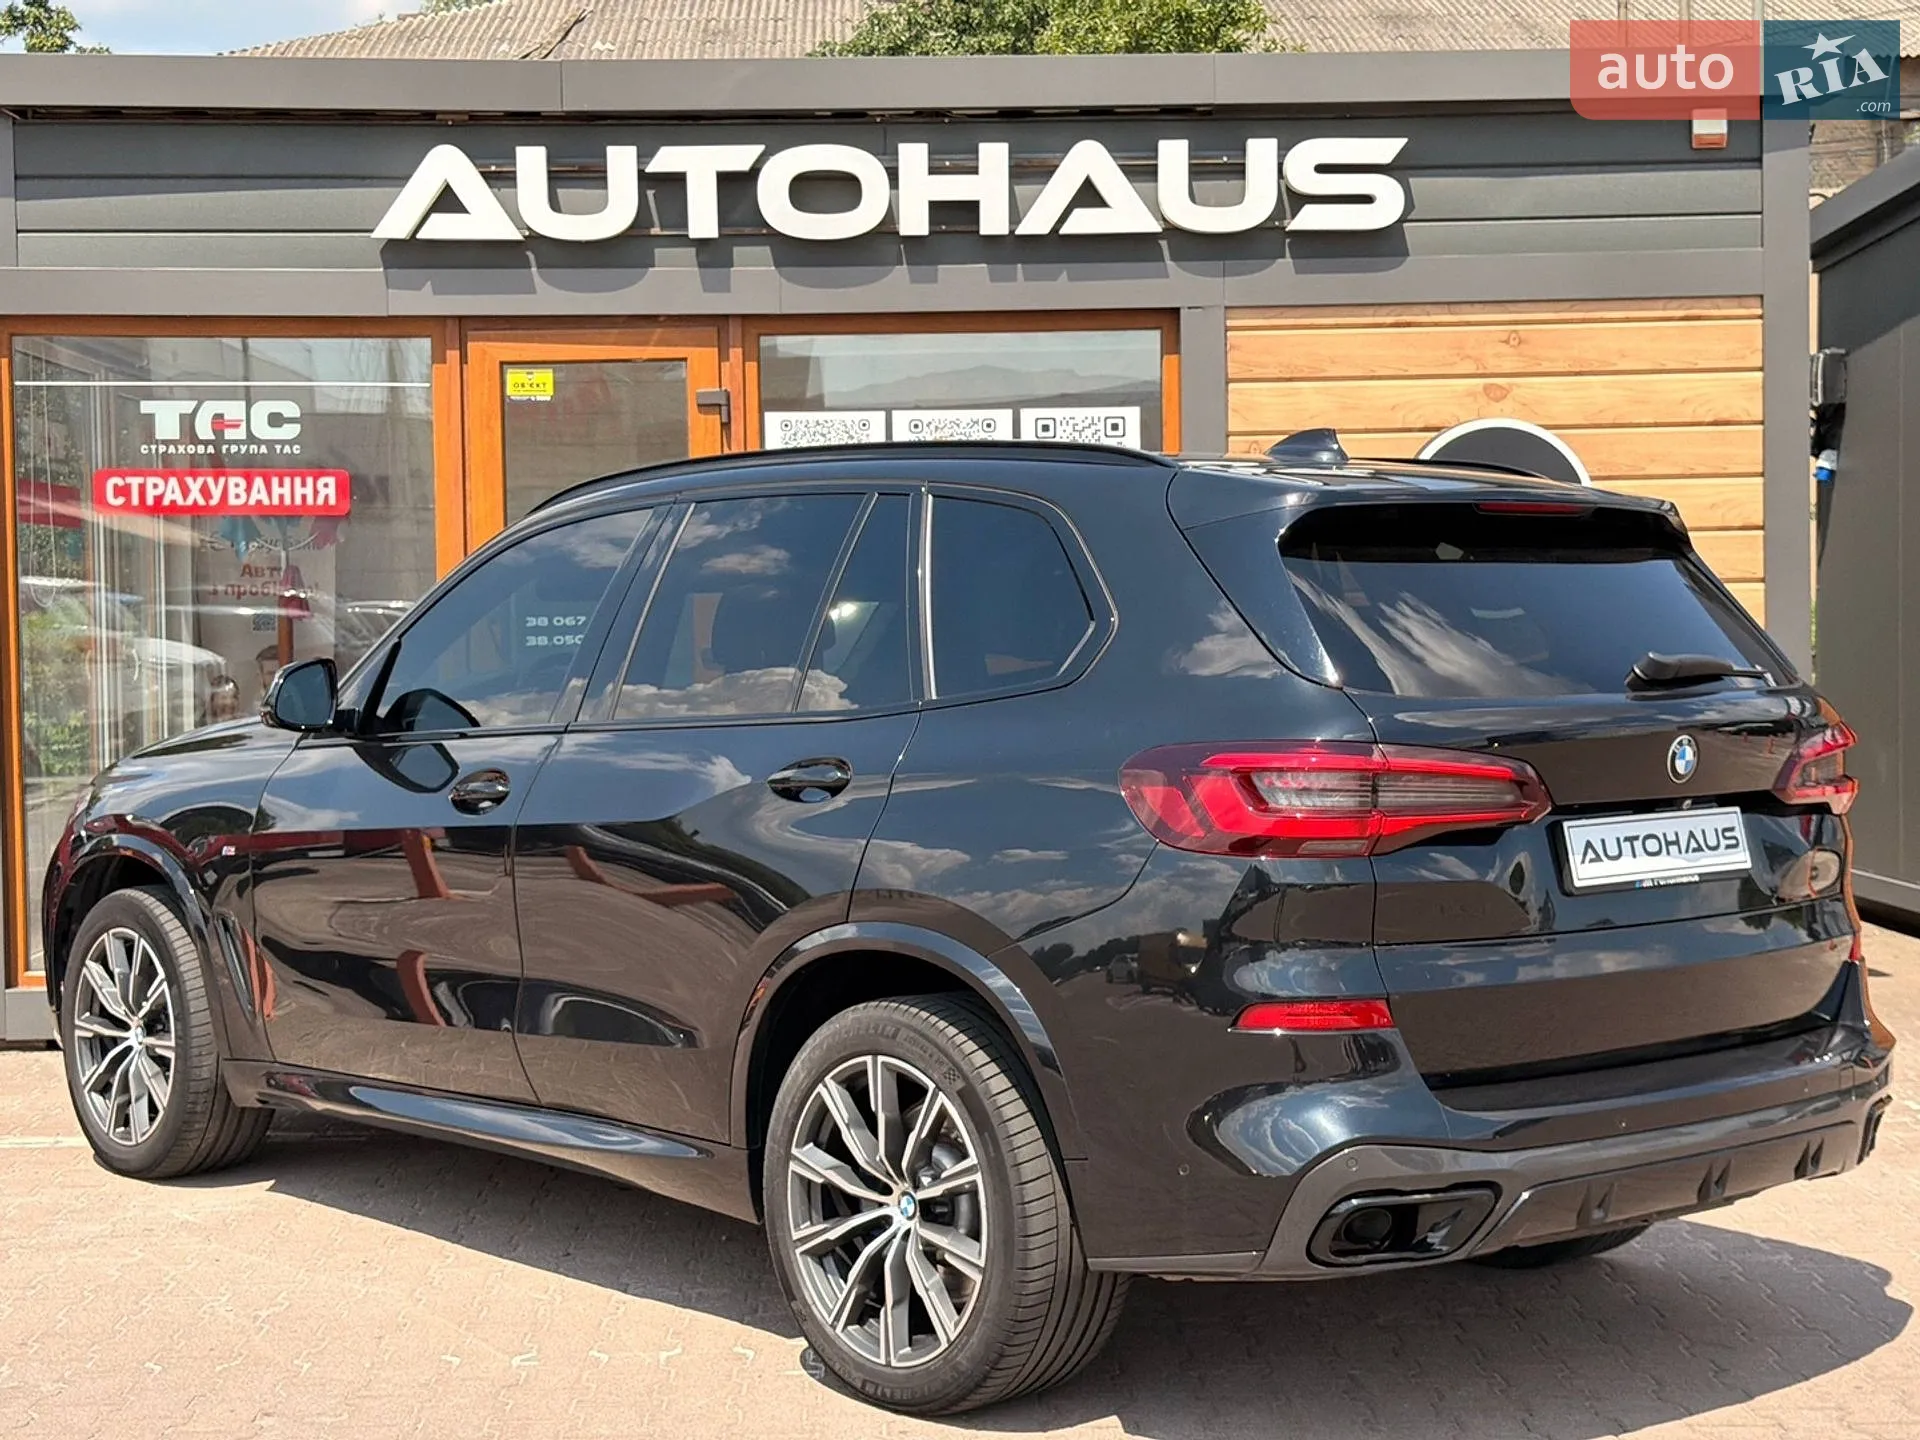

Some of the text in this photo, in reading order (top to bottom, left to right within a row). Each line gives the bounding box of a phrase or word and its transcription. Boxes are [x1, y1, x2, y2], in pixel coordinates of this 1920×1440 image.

[371, 136, 1408, 241] AUTOHAUS
[140, 400, 301, 440] ТАС
[140, 444, 301, 455] СТРАХОВА ГРУПА ТАС
[105, 476, 337, 508] СТРАХУВАННЯ
[240, 563, 282, 578] Авт
[525, 616, 587, 627] 38 067
[1580, 826, 1740, 866] AUTOHAUS
